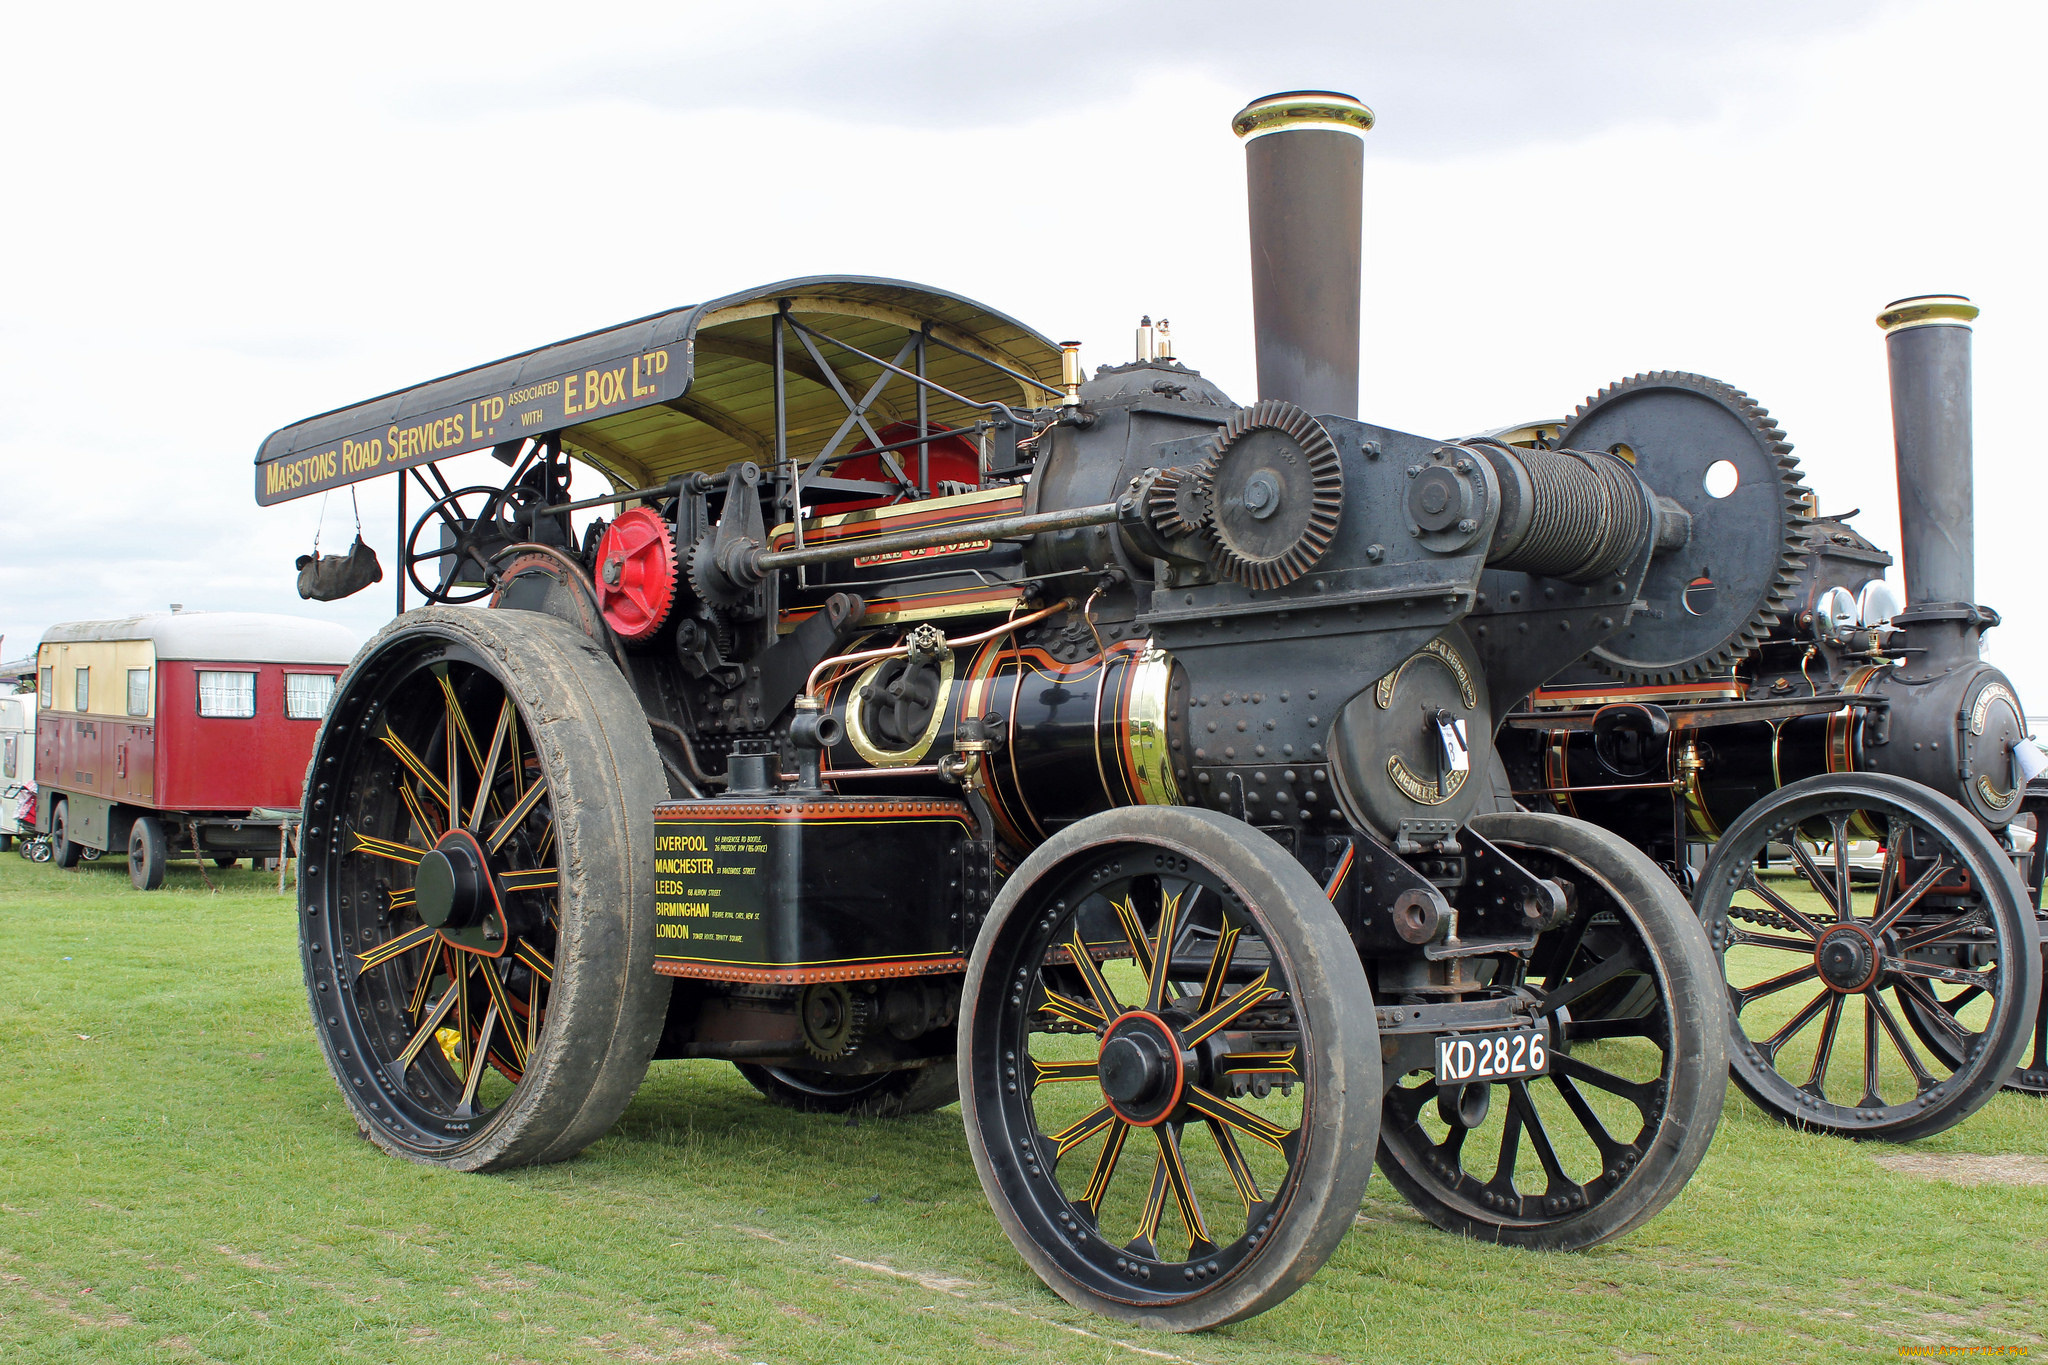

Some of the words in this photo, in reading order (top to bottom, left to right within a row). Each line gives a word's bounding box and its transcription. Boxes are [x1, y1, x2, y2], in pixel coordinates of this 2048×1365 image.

[508, 381, 560, 406] ASSOCIATED
[520, 409, 543, 427] WITH
[266, 450, 337, 496] MARSTONS
[342, 438, 382, 475] ROAD
[386, 414, 465, 462] SERVICES
[1445, 770, 1466, 793] EEDS
[655, 836, 708, 852] LIVERPOOL
[655, 858, 714, 874] MANCHESTER
[655, 880, 684, 896] LEEDS
[655, 902, 710, 918] BIRMINGHAM
[656, 924, 689, 940] LONDON
